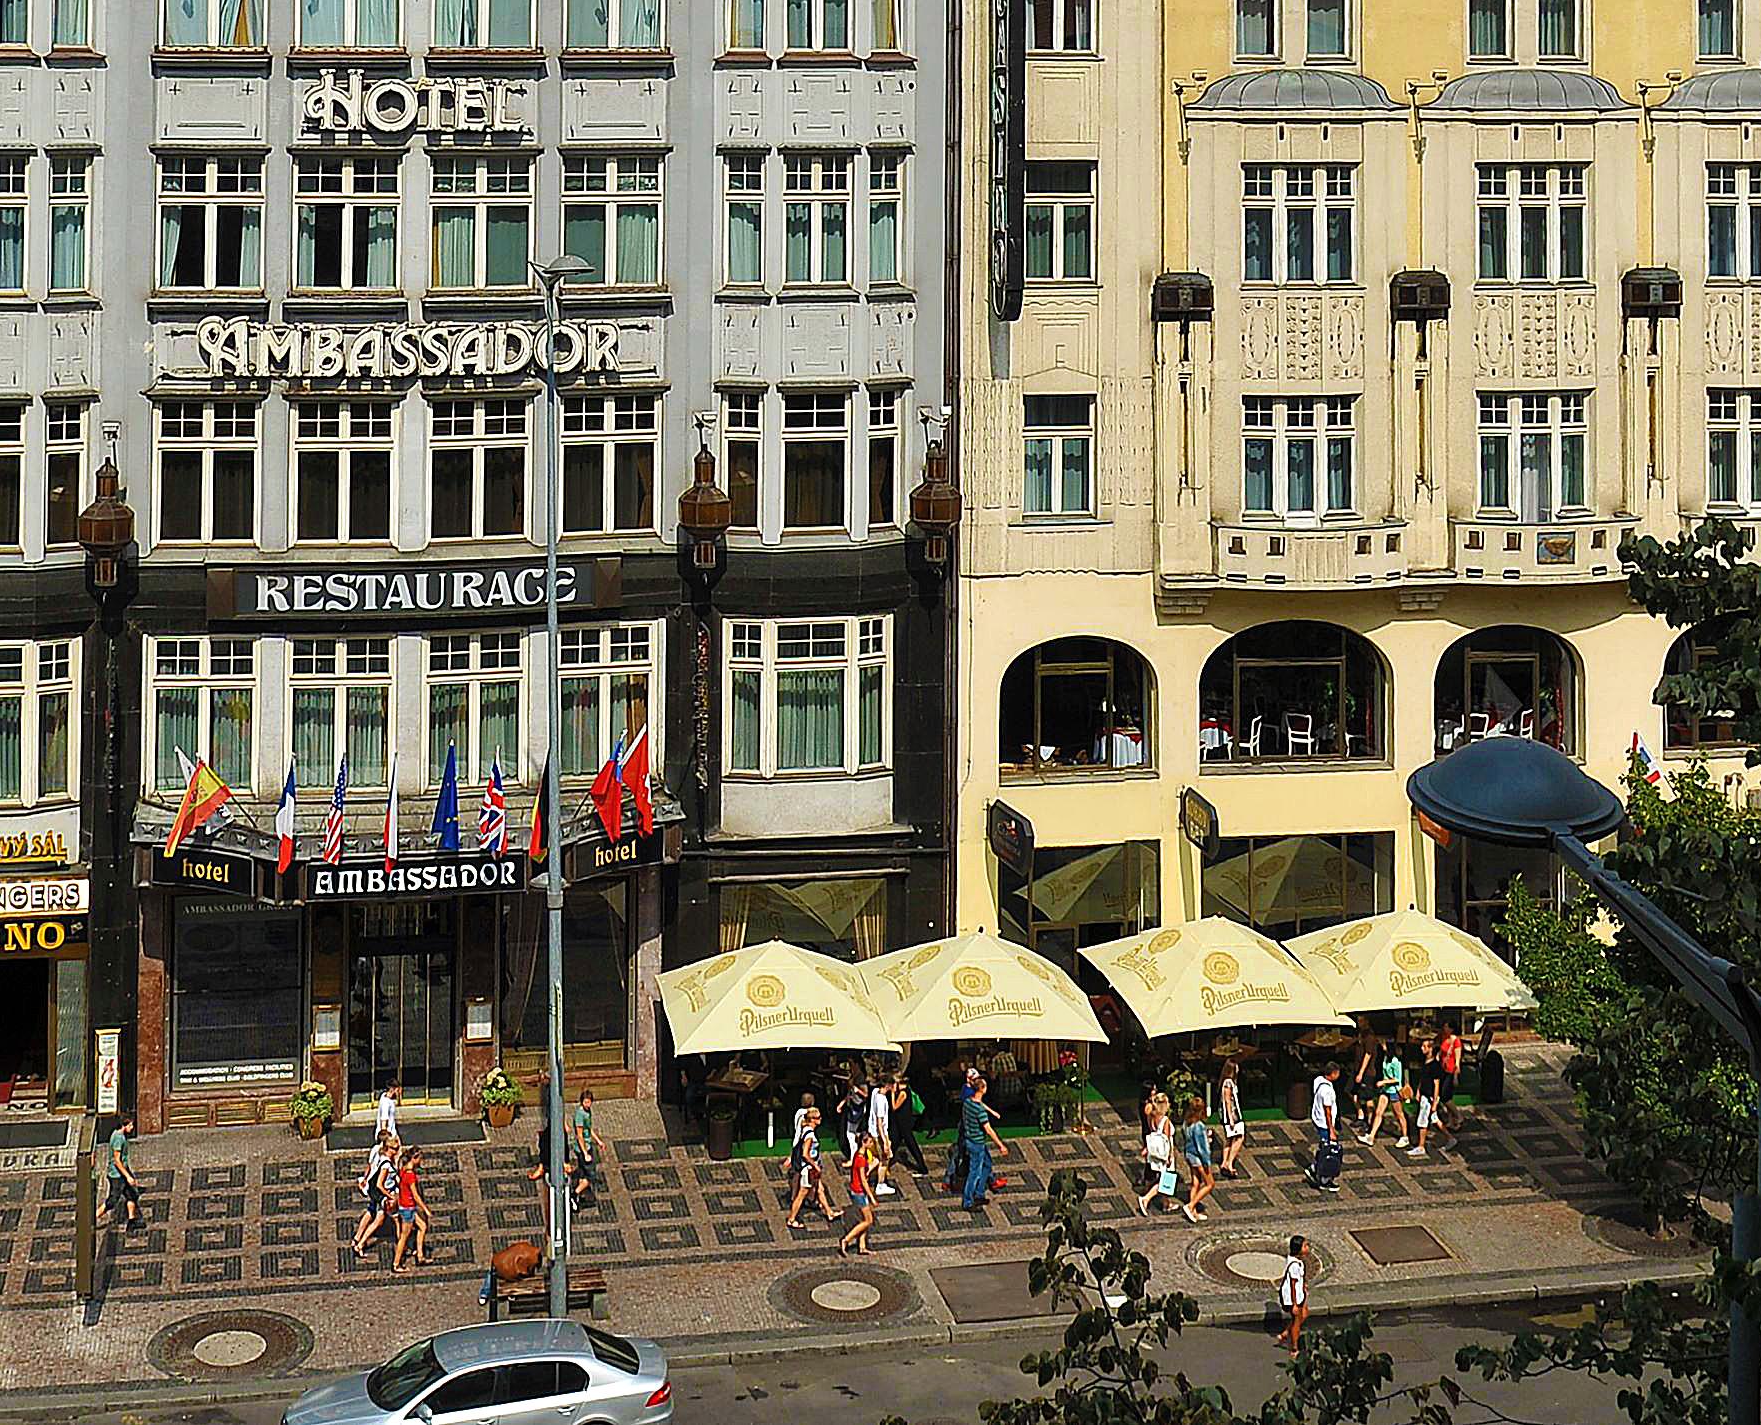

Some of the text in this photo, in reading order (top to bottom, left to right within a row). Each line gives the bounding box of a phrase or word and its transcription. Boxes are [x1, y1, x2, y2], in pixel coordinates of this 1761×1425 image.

[303, 68, 525, 133] HOTEL
[198, 315, 621, 378] AMBASSADOR
[255, 567, 577, 611] RESTAURACE
[30, 829, 68, 857] SÁL
[595, 840, 638, 868] hotel
[182, 858, 230, 884] hotel
[314, 861, 518, 896] AMBASSADOR
[1389, 967, 1481, 997] Pilsner Urquell
[948, 995, 1045, 1028] Pilsner Urquell
[1200, 981, 1291, 1017] Pilsner Urquell
[739, 1005, 836, 1038] Pilsner Urquell
